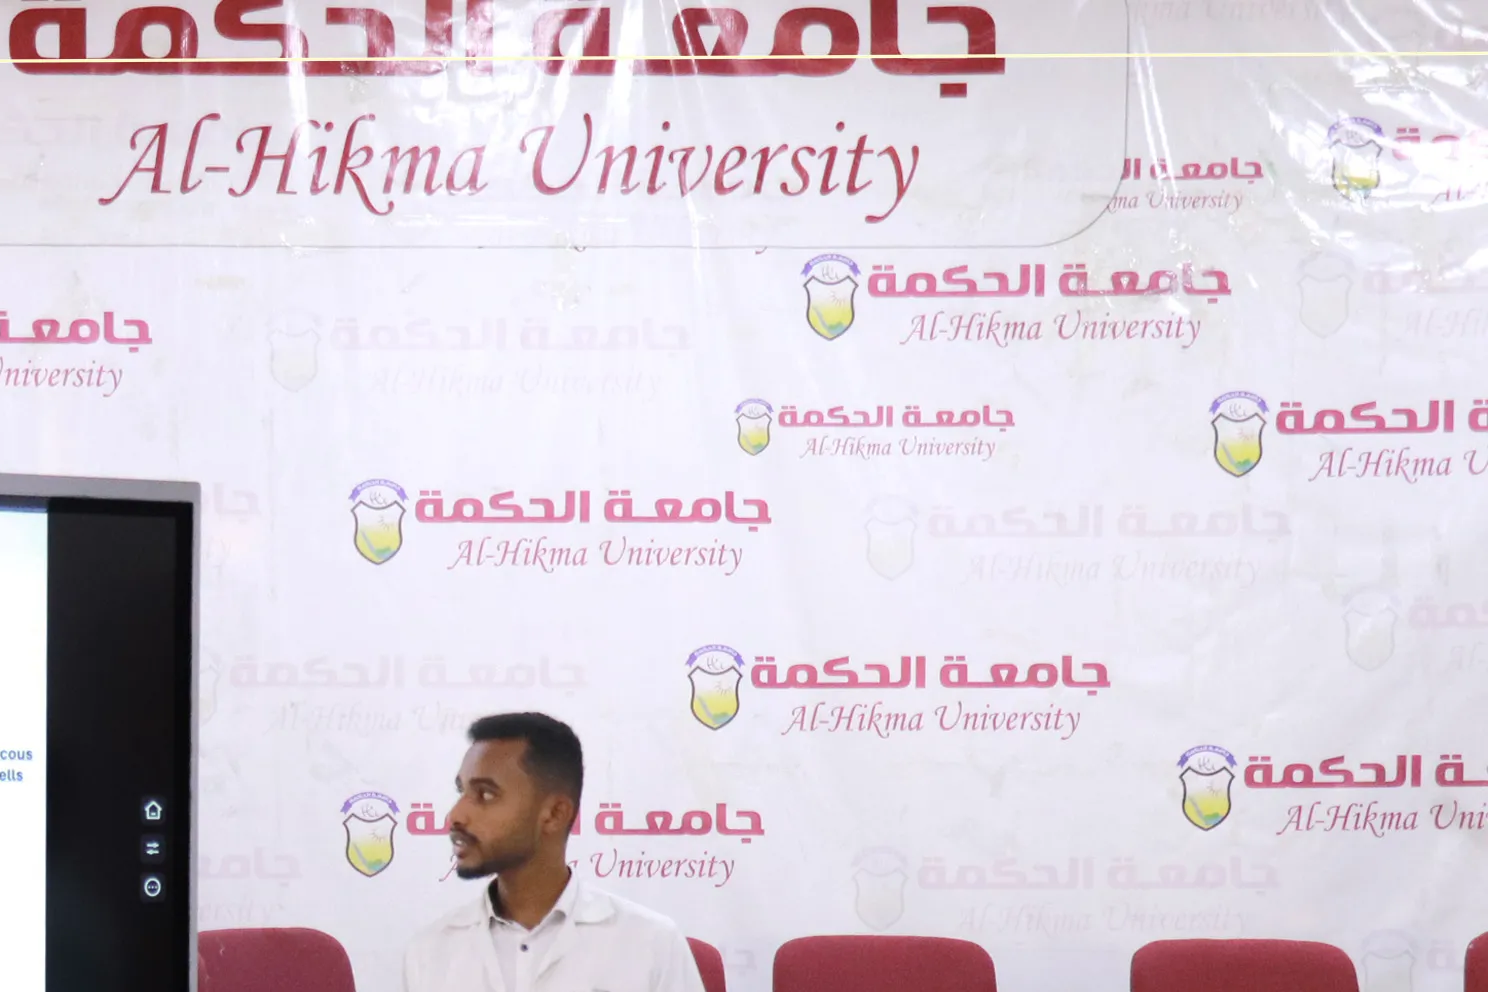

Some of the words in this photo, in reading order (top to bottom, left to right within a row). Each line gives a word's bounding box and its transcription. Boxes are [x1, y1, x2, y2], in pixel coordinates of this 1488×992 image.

[97, 111, 489, 217] Al-Hikma
[516, 109, 923, 227] University
[1151, 156, 1263, 183] جامعة
[868, 264, 1046, 297] الحكمة
[1059, 264, 1231, 303] جامعة
[899, 309, 1044, 349] Al-Hikma
[1054, 309, 1202, 351] University
[779, 406, 894, 427] الحكمة
[903, 404, 1015, 427] جامعة
[1277, 400, 1455, 434] الحكمة
[799, 434, 893, 462] Al-Hikma
[898, 435, 997, 462] University
[1307, 446, 1453, 484] Al-Hikma
[416, 490, 590, 523] الحكمة
[605, 490, 771, 531] جامعة
[447, 536, 589, 575] Al-Hikma
[597, 535, 744, 576] University
[752, 656, 926, 688] الحكمة
[941, 655, 1111, 695] جامعة
[779, 701, 925, 741] Al-Hikma
[931, 701, 1083, 741] University
[1245, 754, 1422, 788] الحكمة
[595, 803, 765, 843] جامعة
[1275, 801, 1420, 839] Al-Hikma
[587, 846, 736, 888] University
